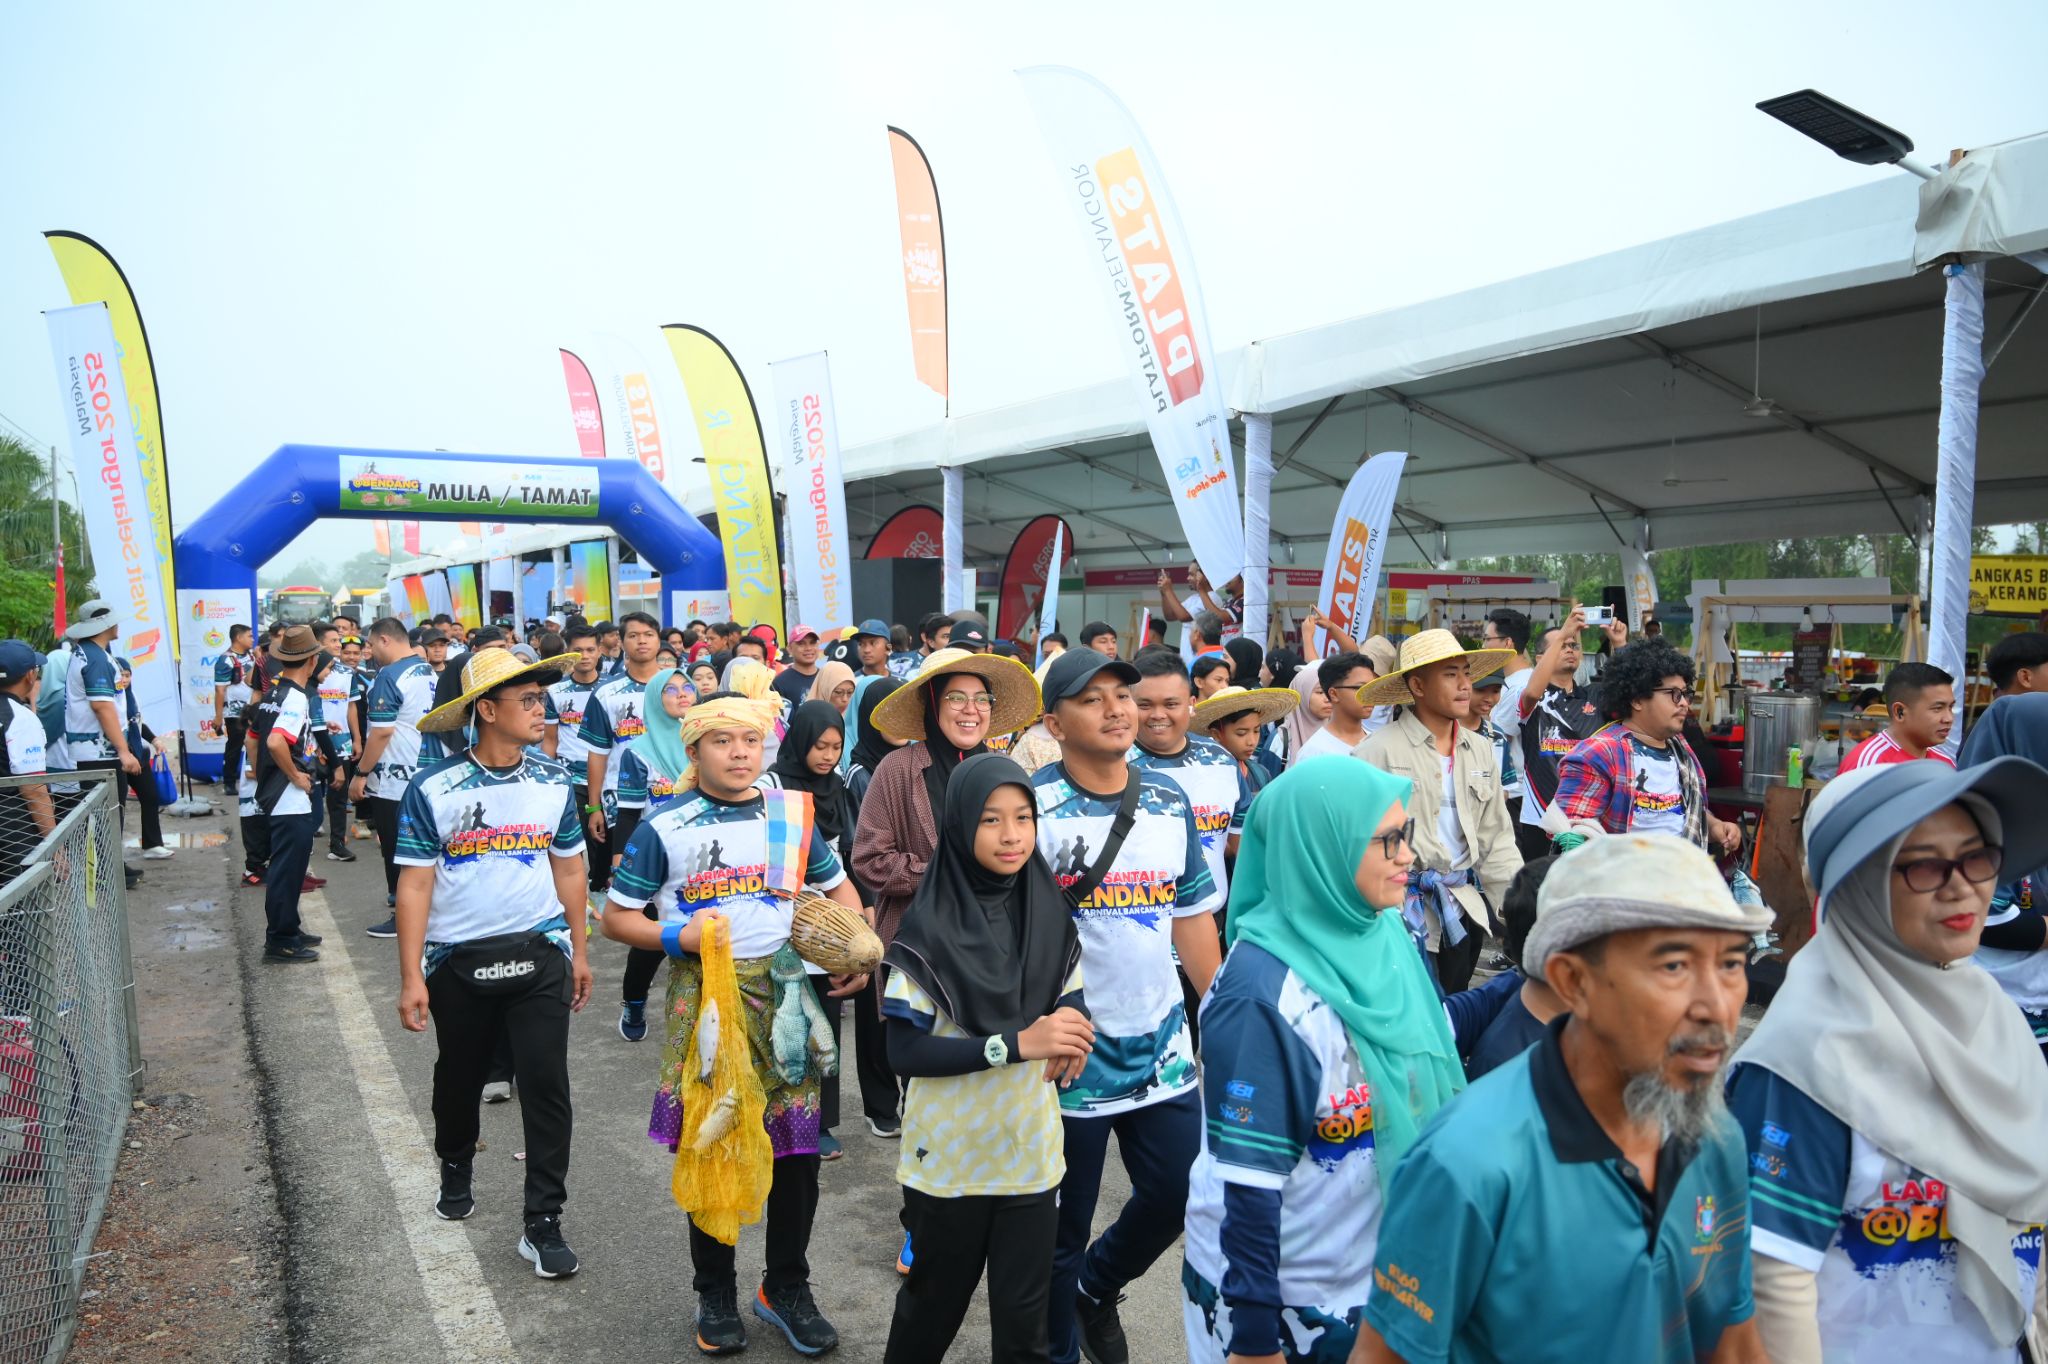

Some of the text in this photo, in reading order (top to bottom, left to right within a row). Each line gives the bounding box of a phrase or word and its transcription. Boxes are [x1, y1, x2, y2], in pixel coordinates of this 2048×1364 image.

[427, 483, 492, 502] MULA
[499, 485, 512, 507] /
[520, 486, 592, 506] TAMAT
[1462, 576, 1481, 585] PPAS
[1969, 568, 2033, 583] ANGKAS
[1989, 586, 2047, 601] KERANG
[453, 824, 537, 841] LARIAN SANTAI
[446, 833, 552, 857] @BENDANG
[687, 869, 736, 884] LARIAN
[1103, 870, 1155, 883] SANTAI
[683, 875, 769, 904] @BEND
[717, 893, 754, 904] KARNIVAL
[1079, 907, 1124, 917] KARNIVAL
[1123, 906, 1140, 915] BAN
[473, 959, 535, 981] adidas
[2012, 1236, 2033, 1250] AN
